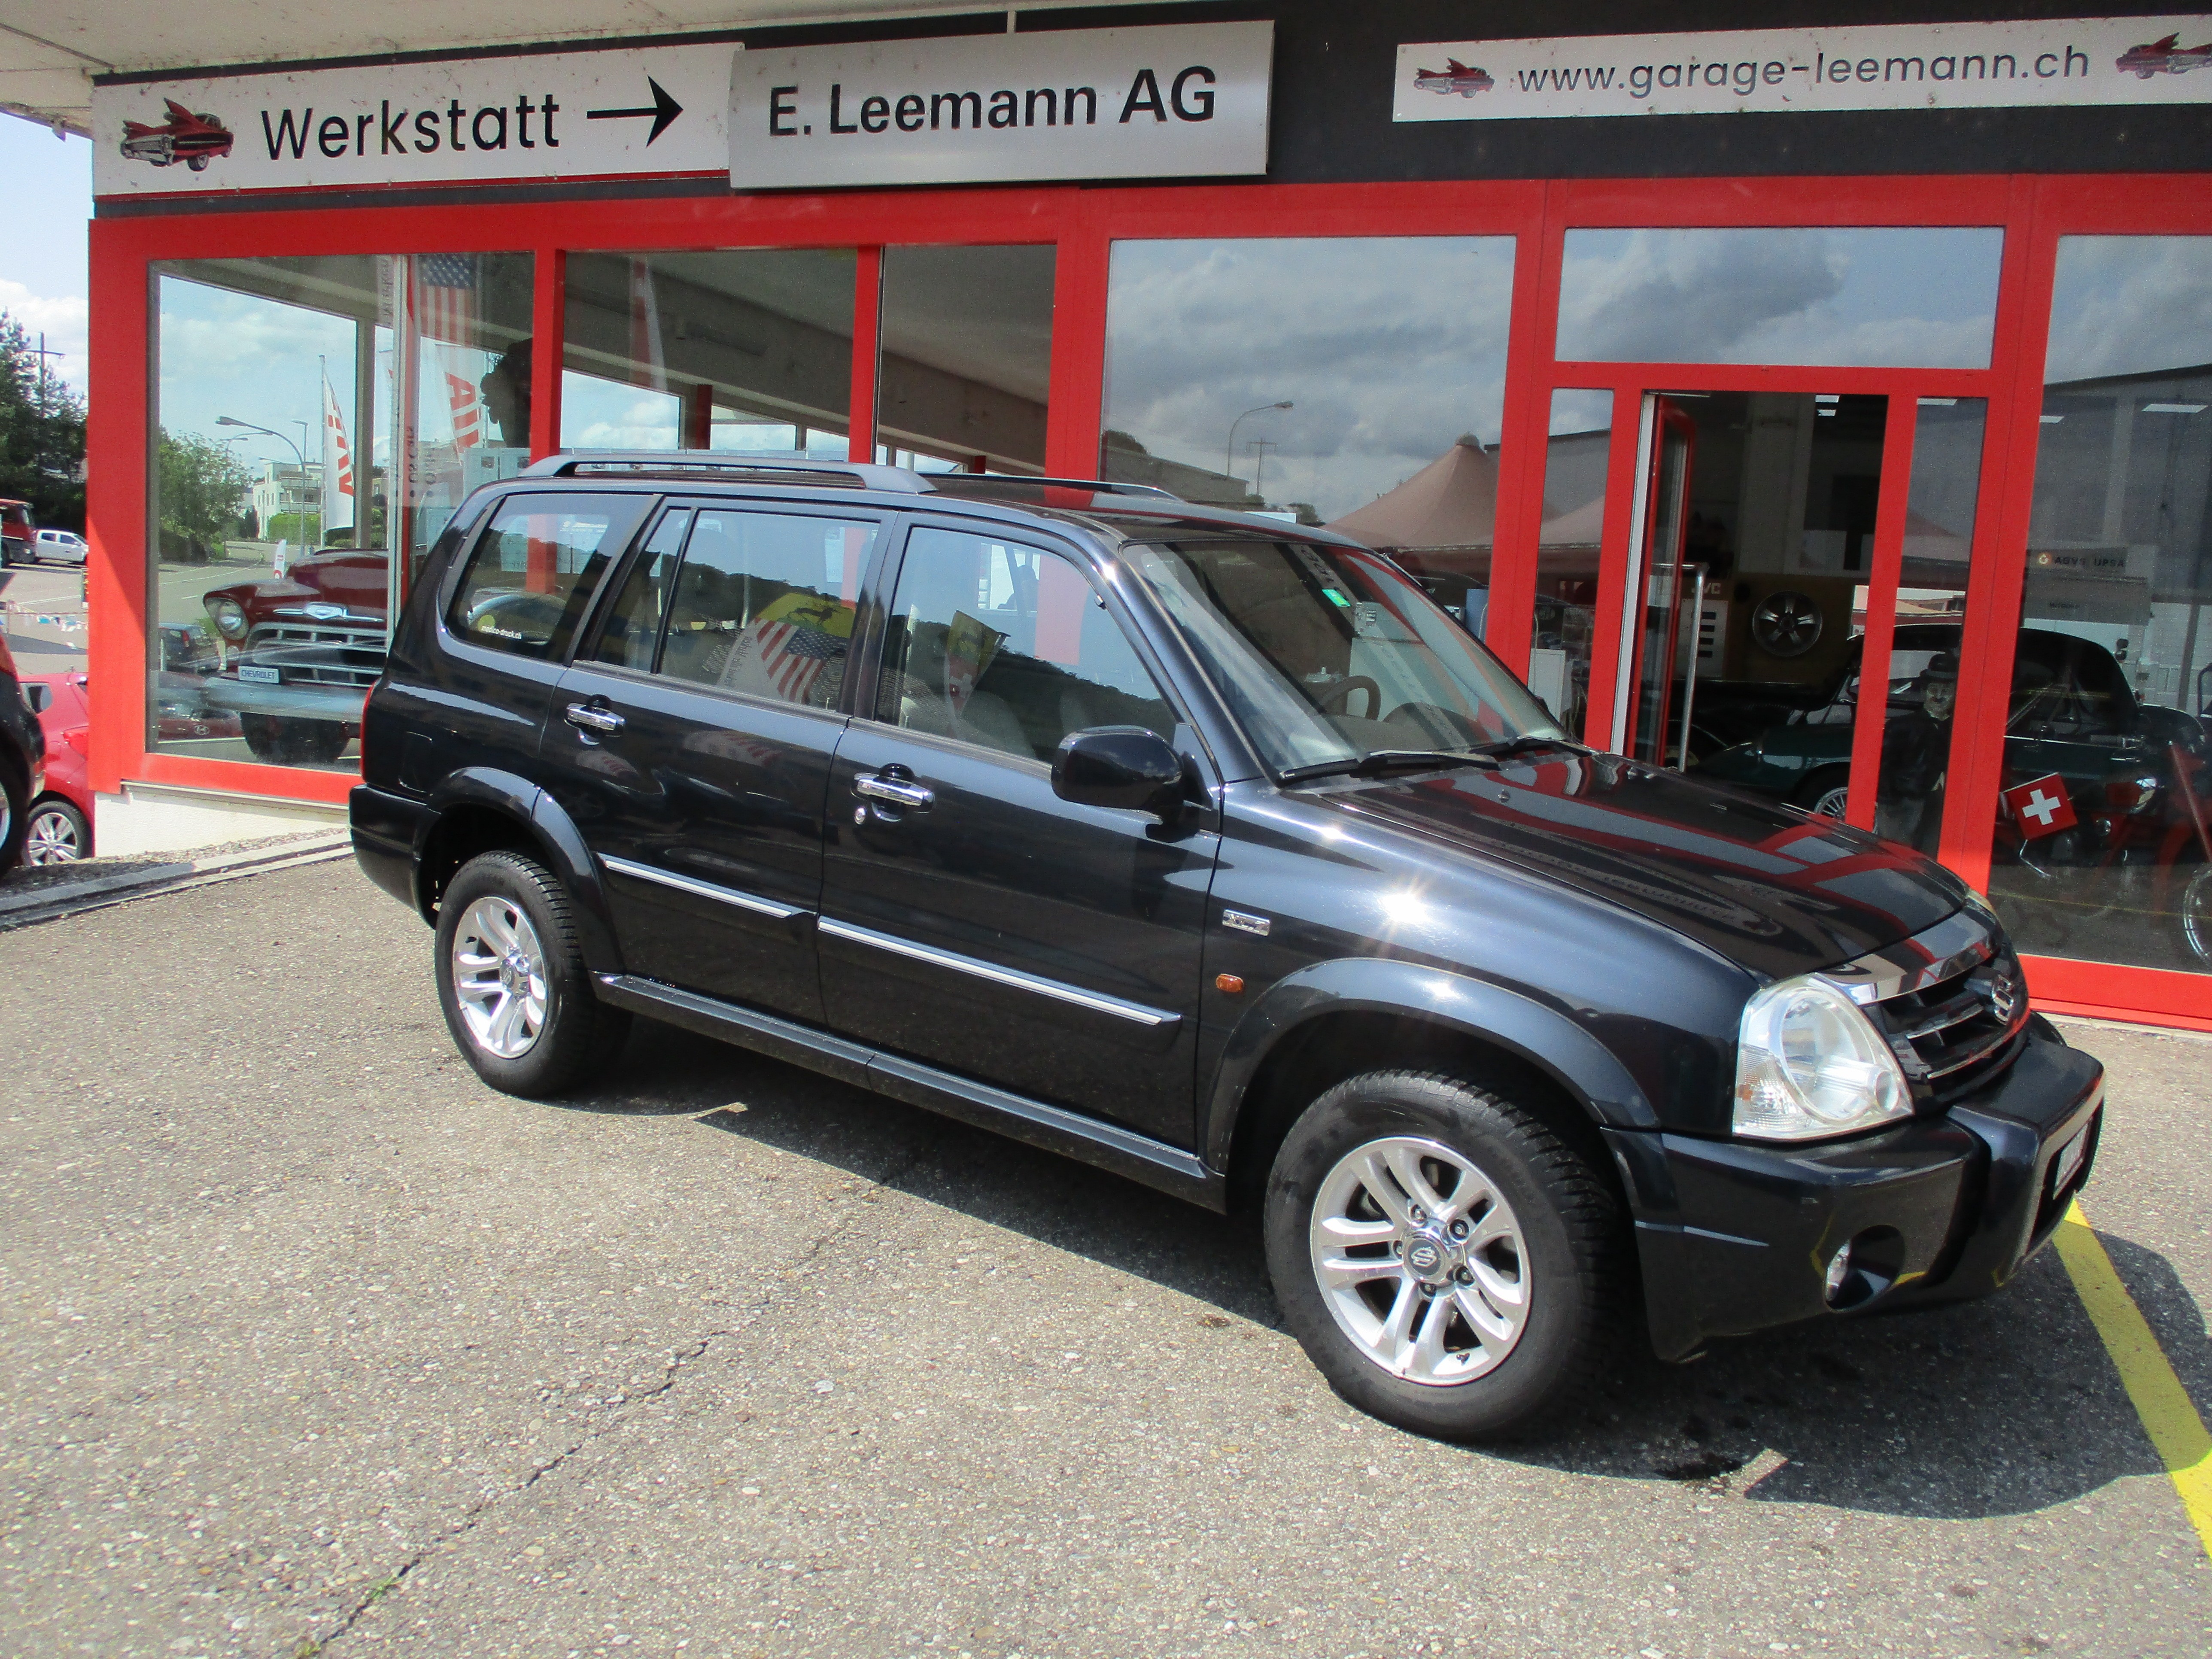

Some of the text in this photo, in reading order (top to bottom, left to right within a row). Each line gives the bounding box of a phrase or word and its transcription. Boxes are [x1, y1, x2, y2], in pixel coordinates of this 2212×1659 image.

[1518, 45, 2088, 98] www.garage-leemann.ch
[261, 94, 560, 161] Werkstatt
[769, 65, 1216, 137] E. Leemann AG
[1691, 582, 1722, 595] VC
[241, 668, 276, 680] CHEVROLET
